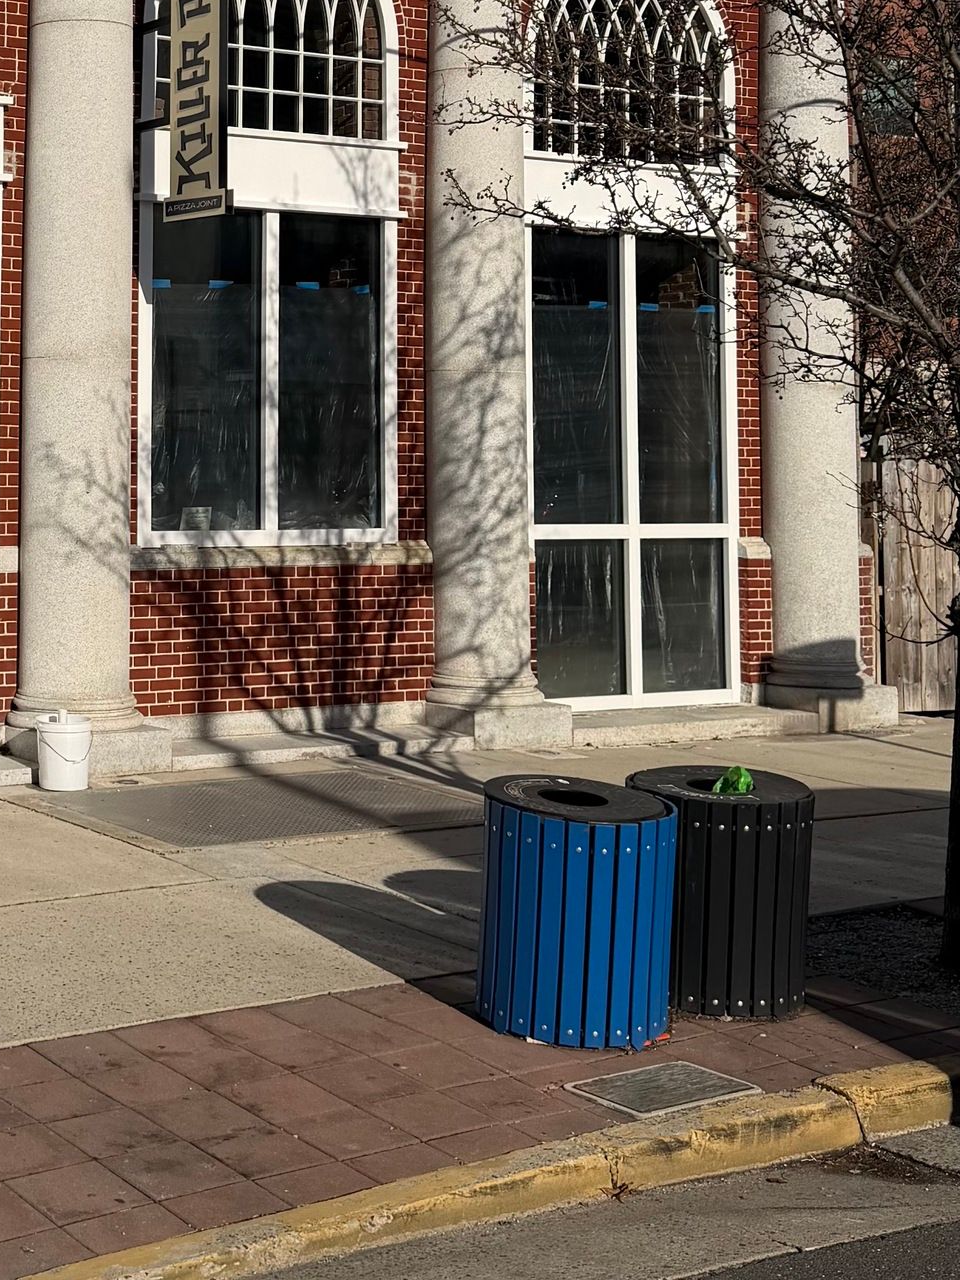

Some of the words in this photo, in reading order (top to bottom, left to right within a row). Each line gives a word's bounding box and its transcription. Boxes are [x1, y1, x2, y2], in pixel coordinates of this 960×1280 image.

[175, 32, 213, 195] KILLER
[173, 202, 196, 211] PIZZA
[196, 198, 219, 209] JOINT
